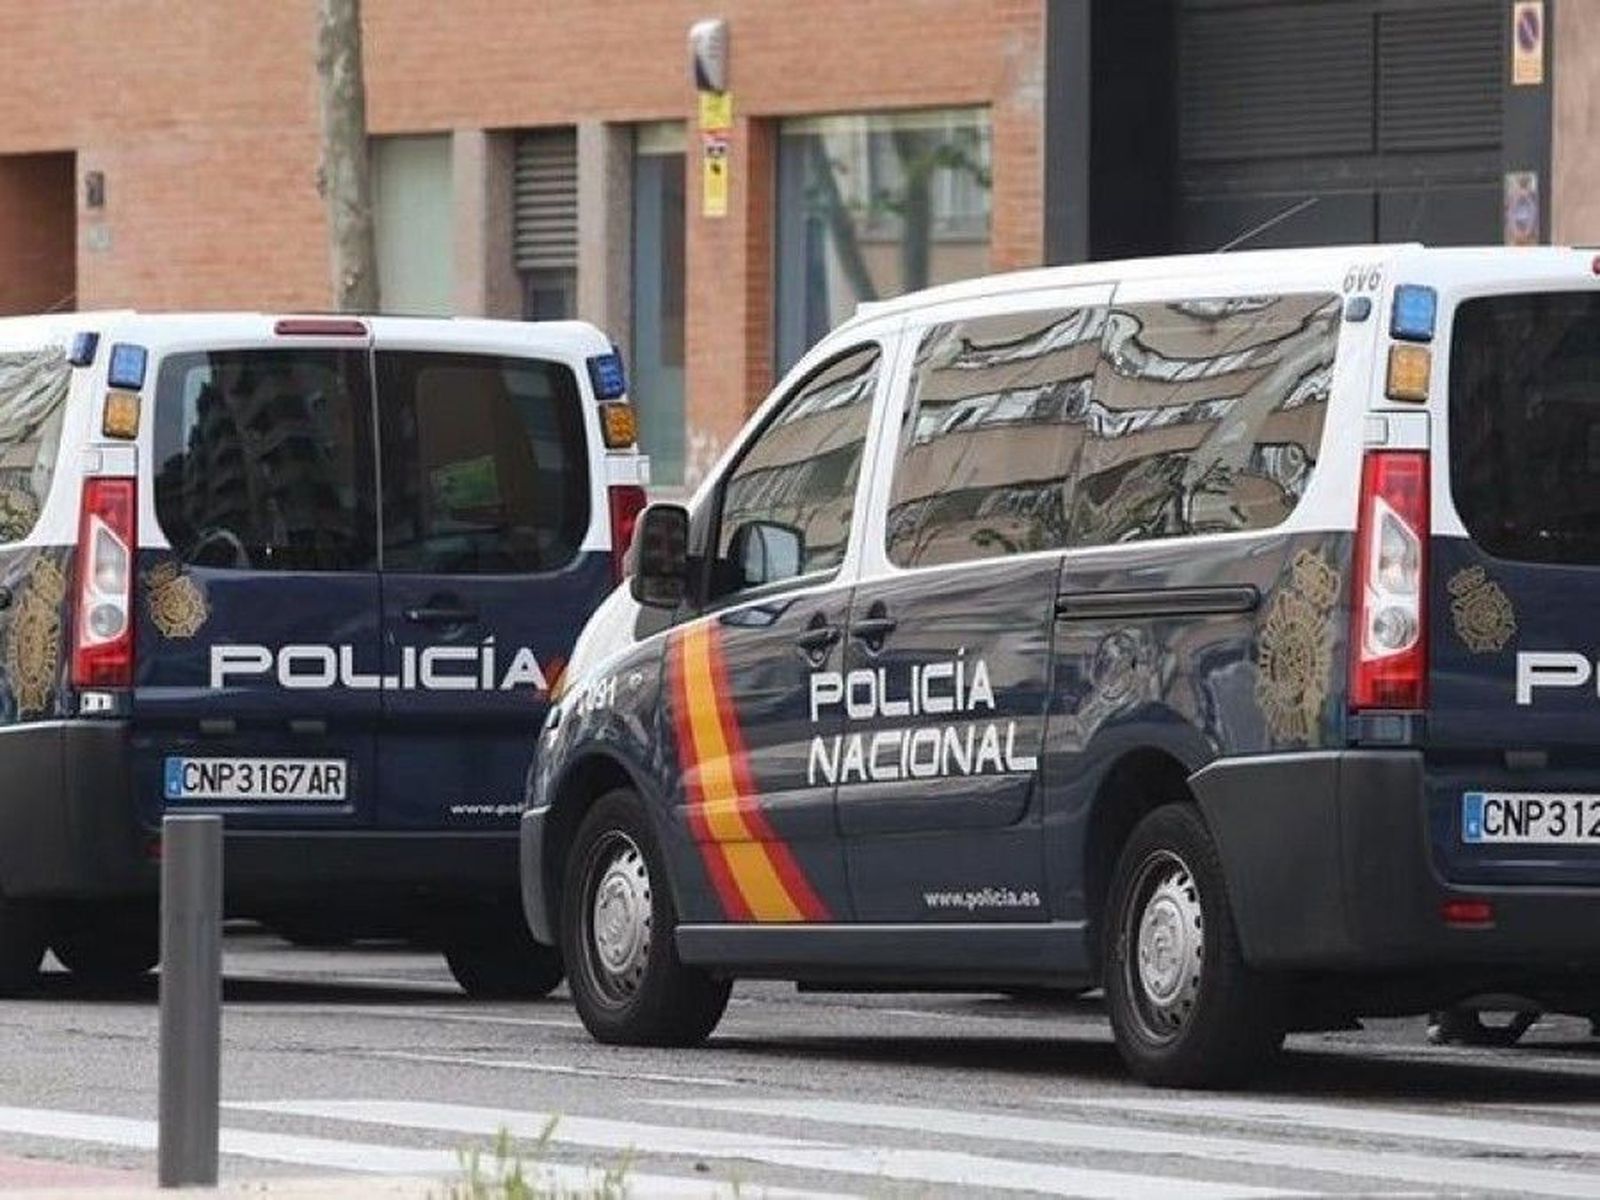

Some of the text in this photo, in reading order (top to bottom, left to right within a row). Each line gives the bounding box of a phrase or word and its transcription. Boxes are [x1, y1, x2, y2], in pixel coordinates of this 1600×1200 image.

[210, 635, 548, 690] POLICÍA
[809, 646, 996, 722] POLICÍA
[1516, 652, 1600, 705] P
[182, 762, 342, 795] CNP3167AR
[807, 721, 1038, 785] NACIONAL
[1484, 800, 1600, 838] CNP312
[923, 887, 1040, 911] www.policia.es
